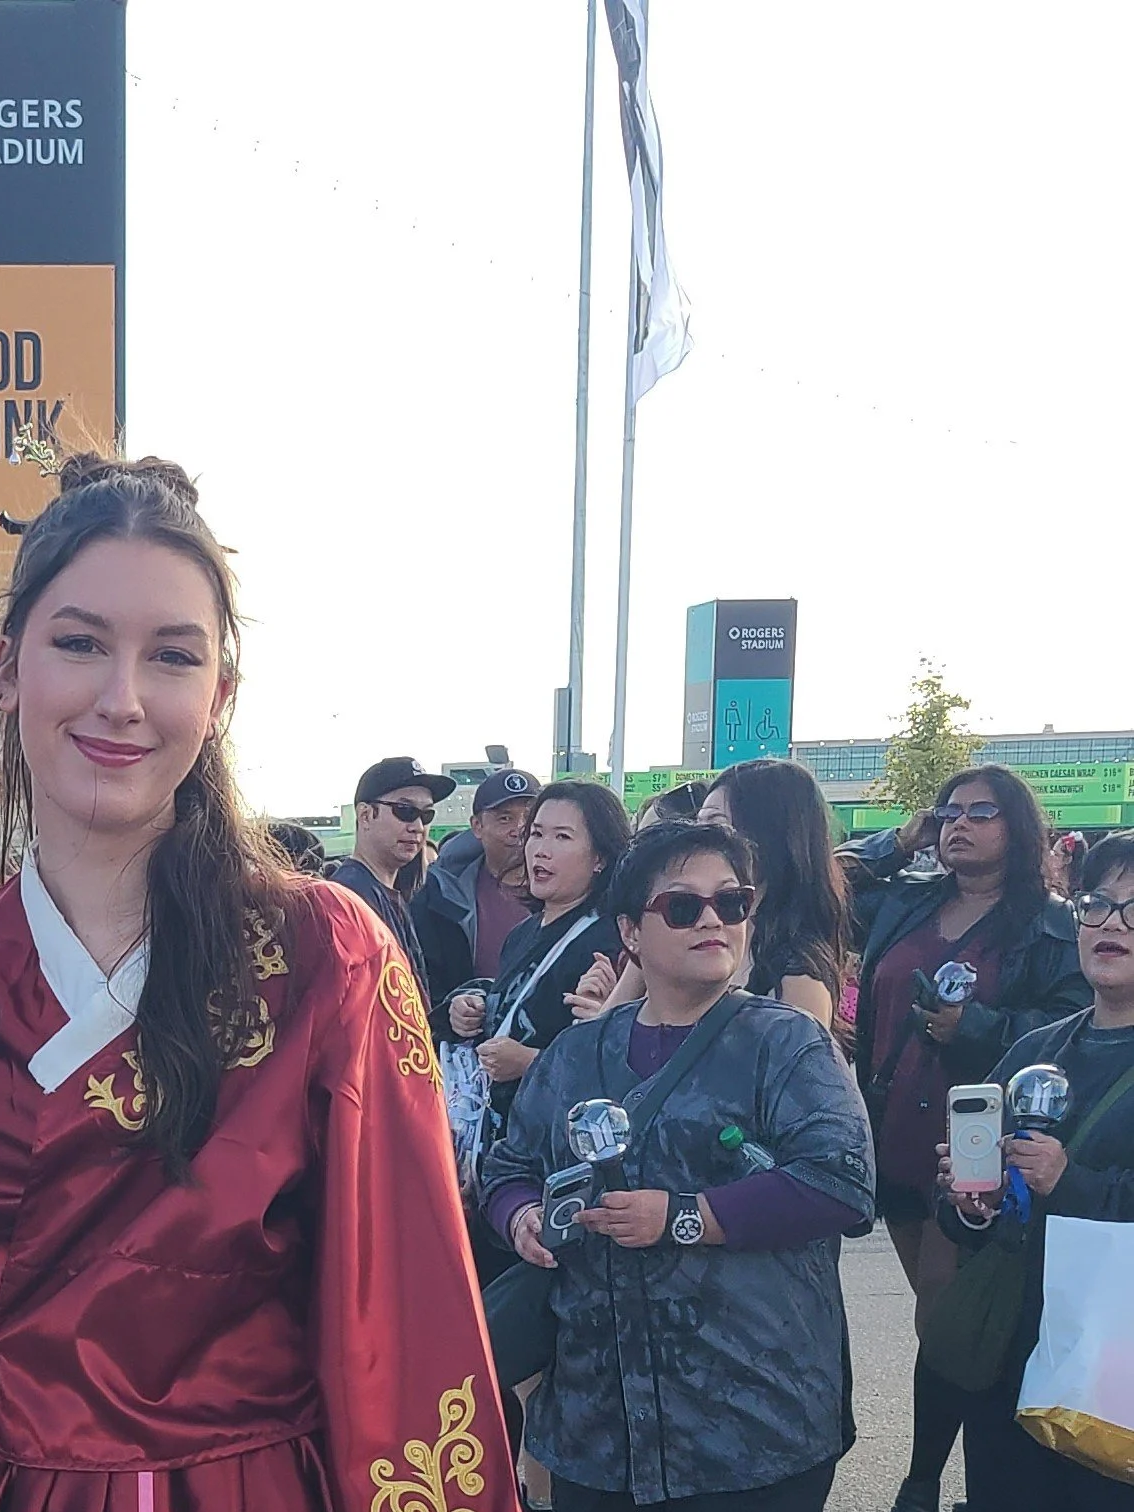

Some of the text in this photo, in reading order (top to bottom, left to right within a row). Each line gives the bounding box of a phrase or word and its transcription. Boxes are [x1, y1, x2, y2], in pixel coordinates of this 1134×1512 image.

[741, 627, 785, 639] ROGERS
[741, 639, 784, 650] STADIUM
[1050, 769, 1076, 779] CAESAR
[1077, 768, 1096, 778] WRAP
[1050, 784, 1083, 794] SANDWICH
